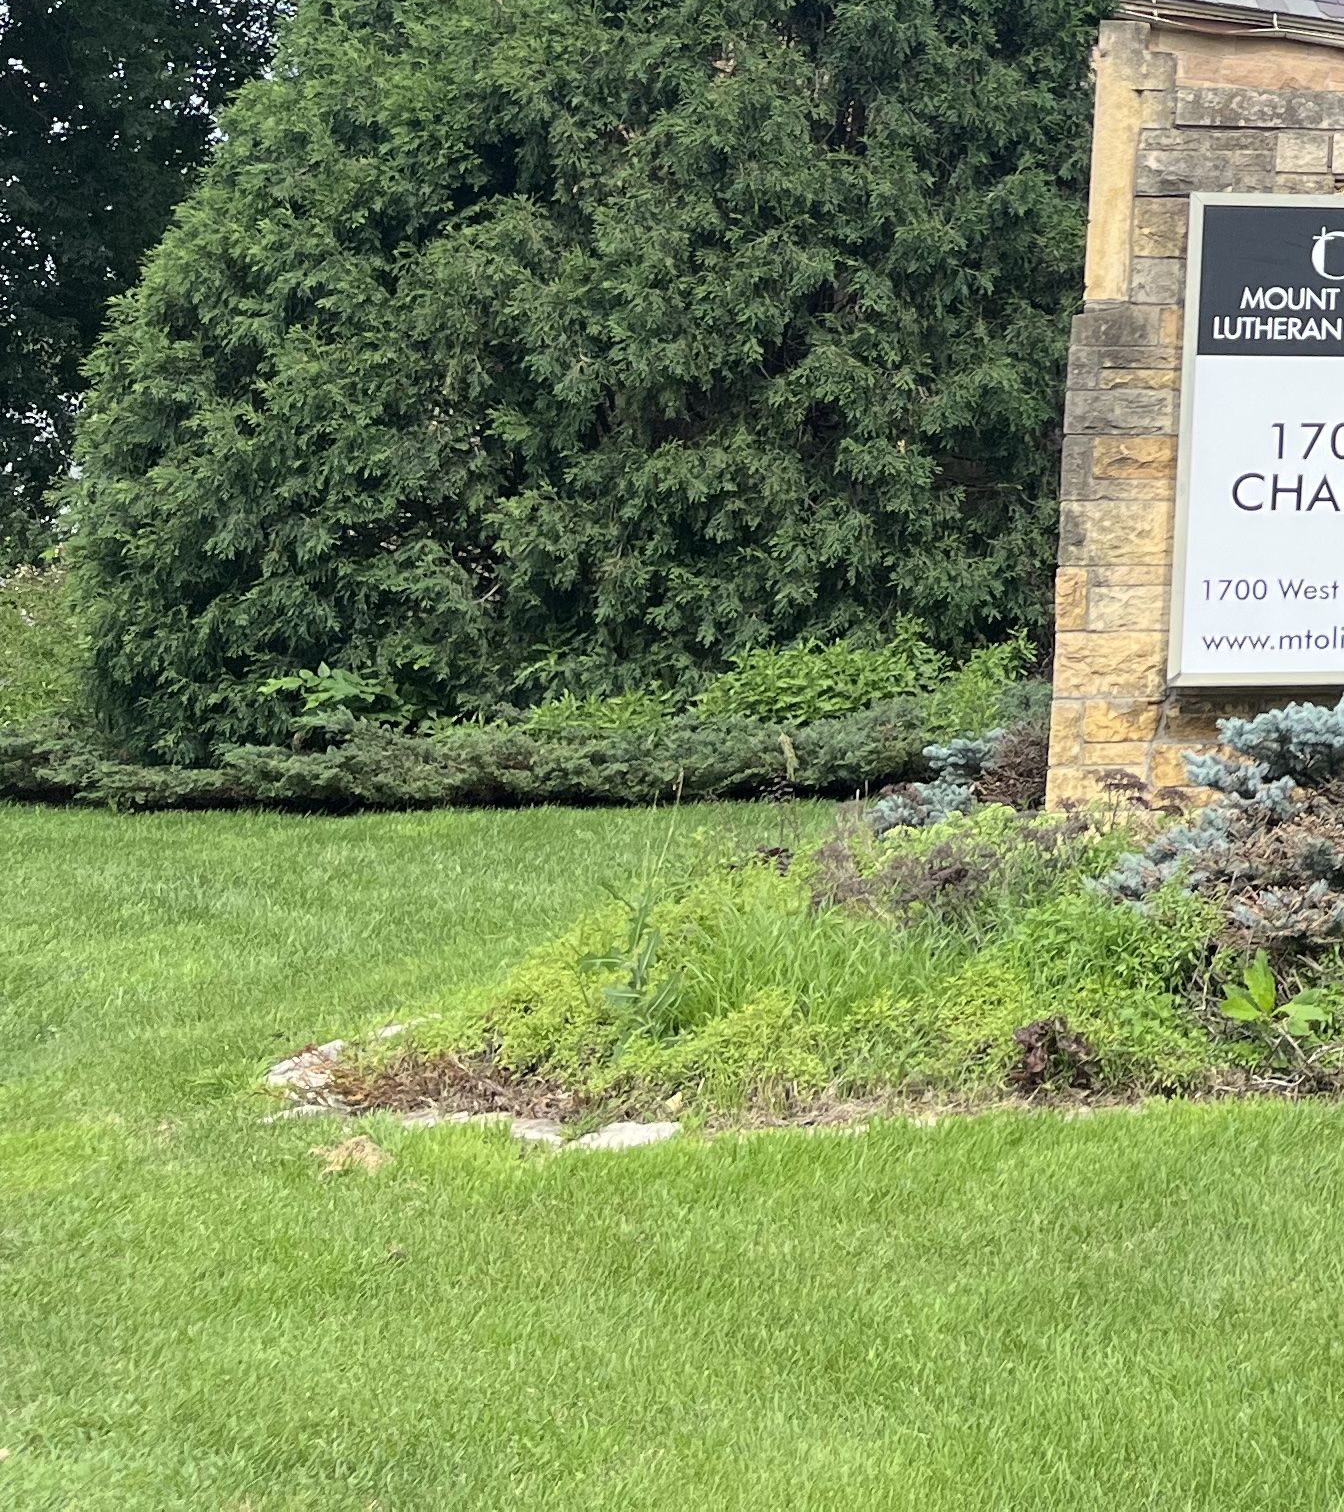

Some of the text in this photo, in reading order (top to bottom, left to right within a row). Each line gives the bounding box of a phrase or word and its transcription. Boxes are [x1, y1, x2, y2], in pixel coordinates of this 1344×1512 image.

[1240, 286, 1341, 311] MOUNT
[1212, 316, 1343, 341] LUTHERAN
[1202, 579, 1268, 601] 1700
[1278, 578, 1339, 600] West
